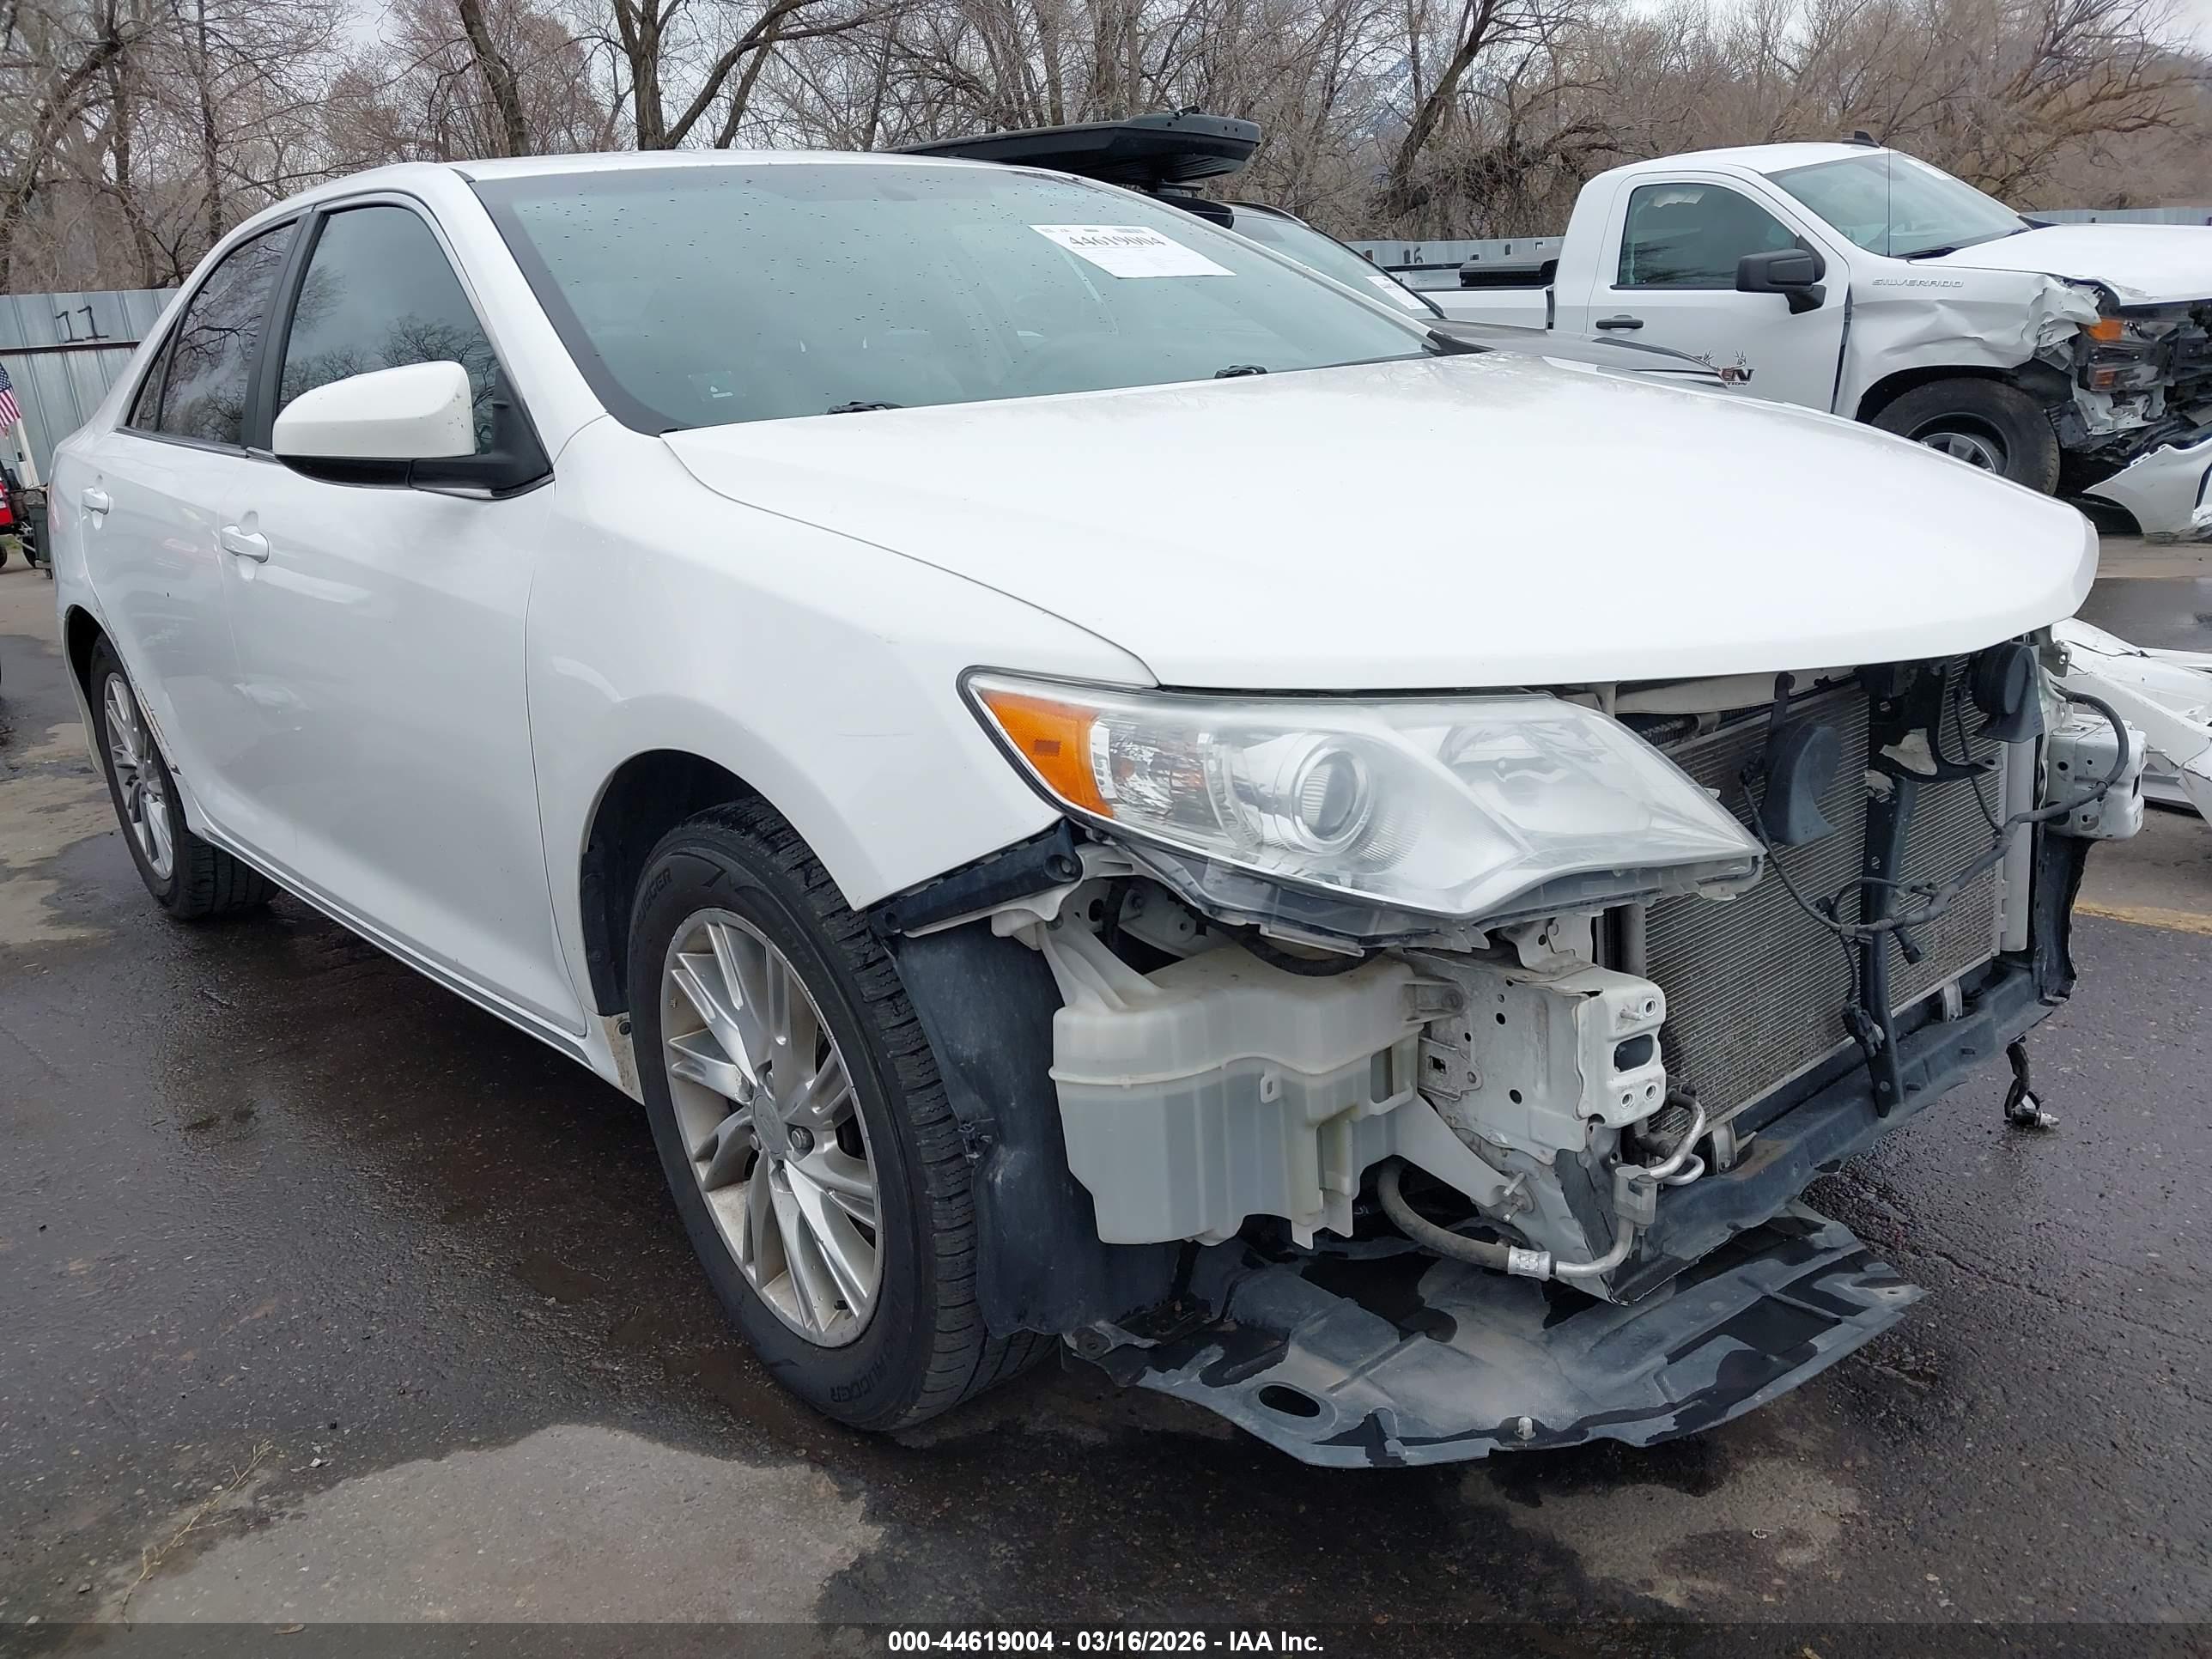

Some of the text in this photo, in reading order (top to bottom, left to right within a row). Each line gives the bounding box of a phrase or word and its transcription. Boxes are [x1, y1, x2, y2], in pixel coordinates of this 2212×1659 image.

[1069, 236, 1166, 246] 44619004
[1872, 278, 1964, 288] SILVERADO
[55, 305, 110, 343] 11
